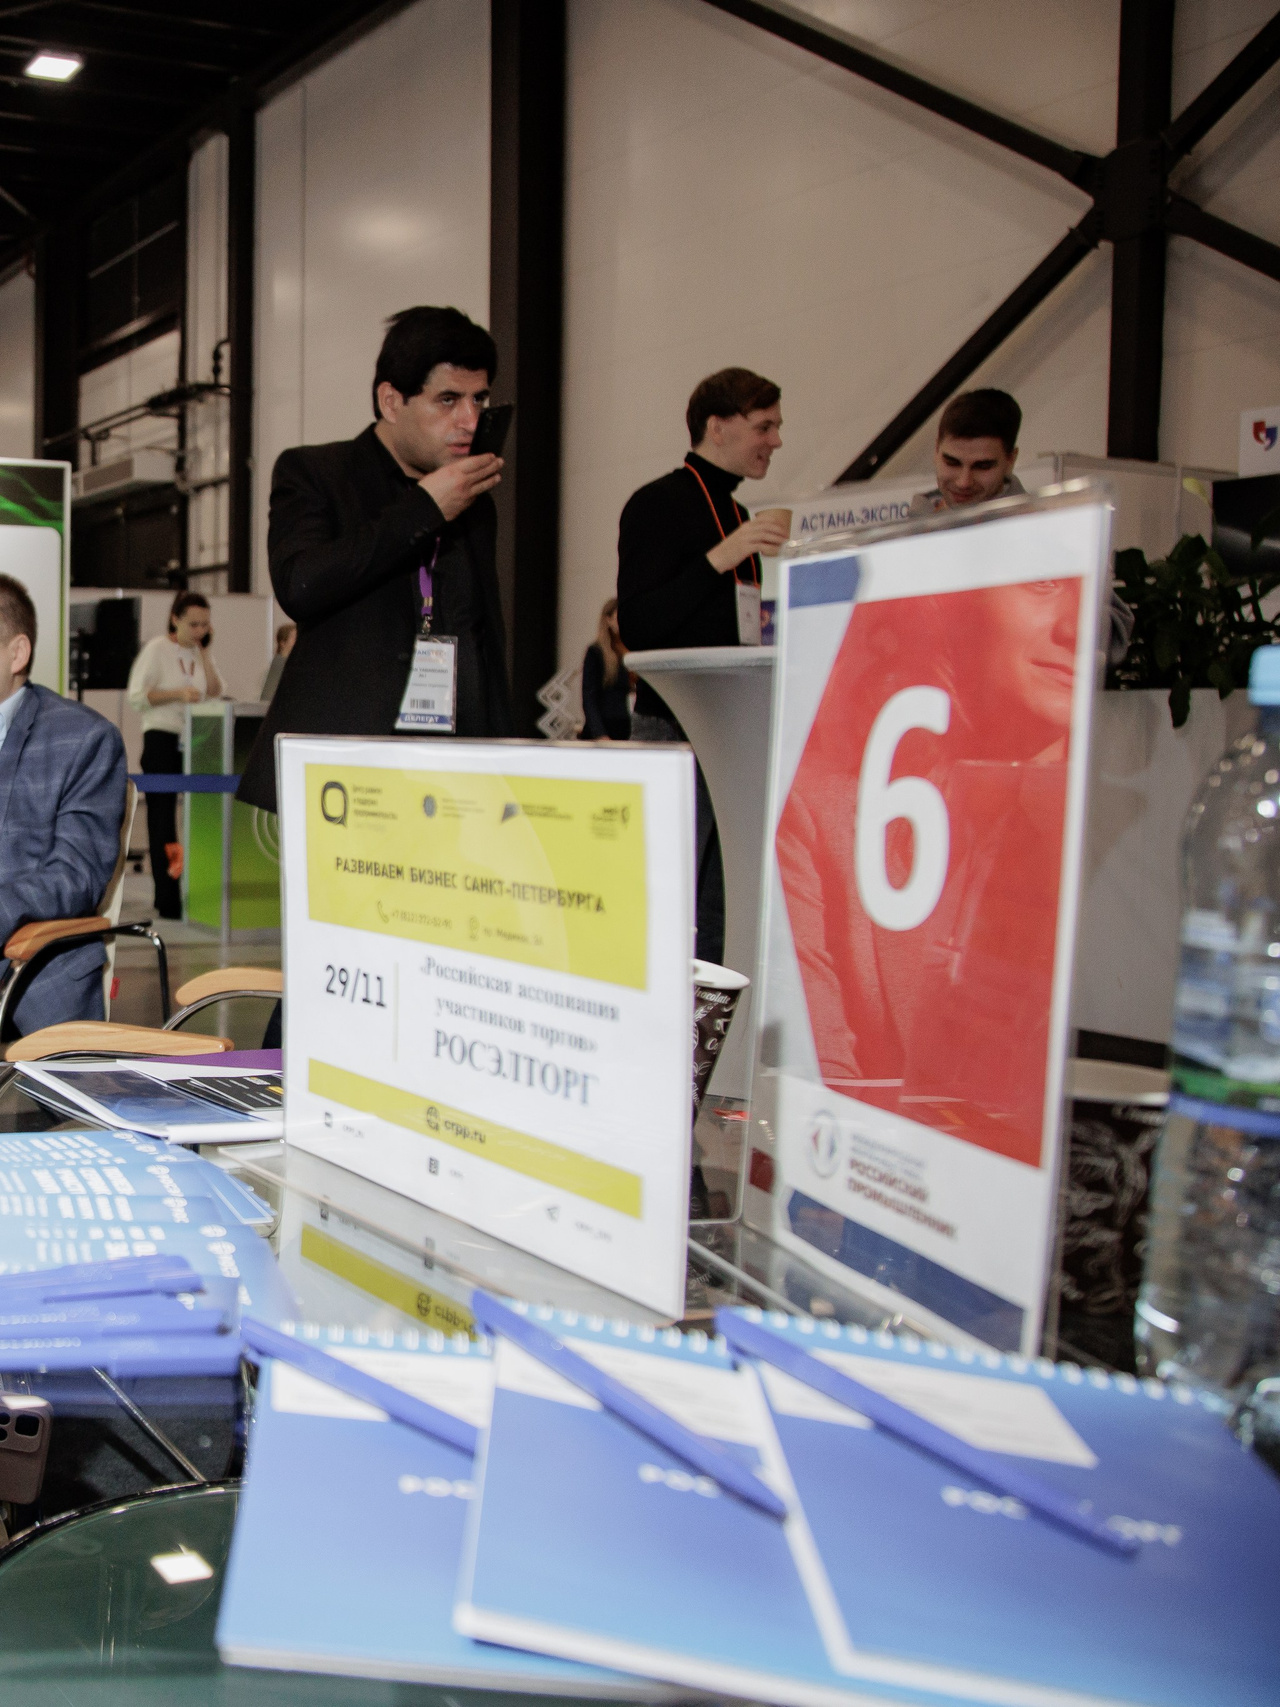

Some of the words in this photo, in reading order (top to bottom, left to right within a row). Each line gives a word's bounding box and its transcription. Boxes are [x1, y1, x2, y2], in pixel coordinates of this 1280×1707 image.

[854, 685, 951, 932] 6
[335, 856, 405, 881] РАЗВИВАЕМ
[410, 867, 458, 890] БИЗНЕС
[464, 875, 607, 914] САНКТ-ПЕТЕРБУРГА
[325, 964, 388, 1009] 29/11
[517, 982, 620, 1023] ассоциация
[435, 997, 526, 1034] участников
[433, 1028, 600, 1105] РОСЭЛТОРГ
[443, 1118, 487, 1144] crpp.ru
